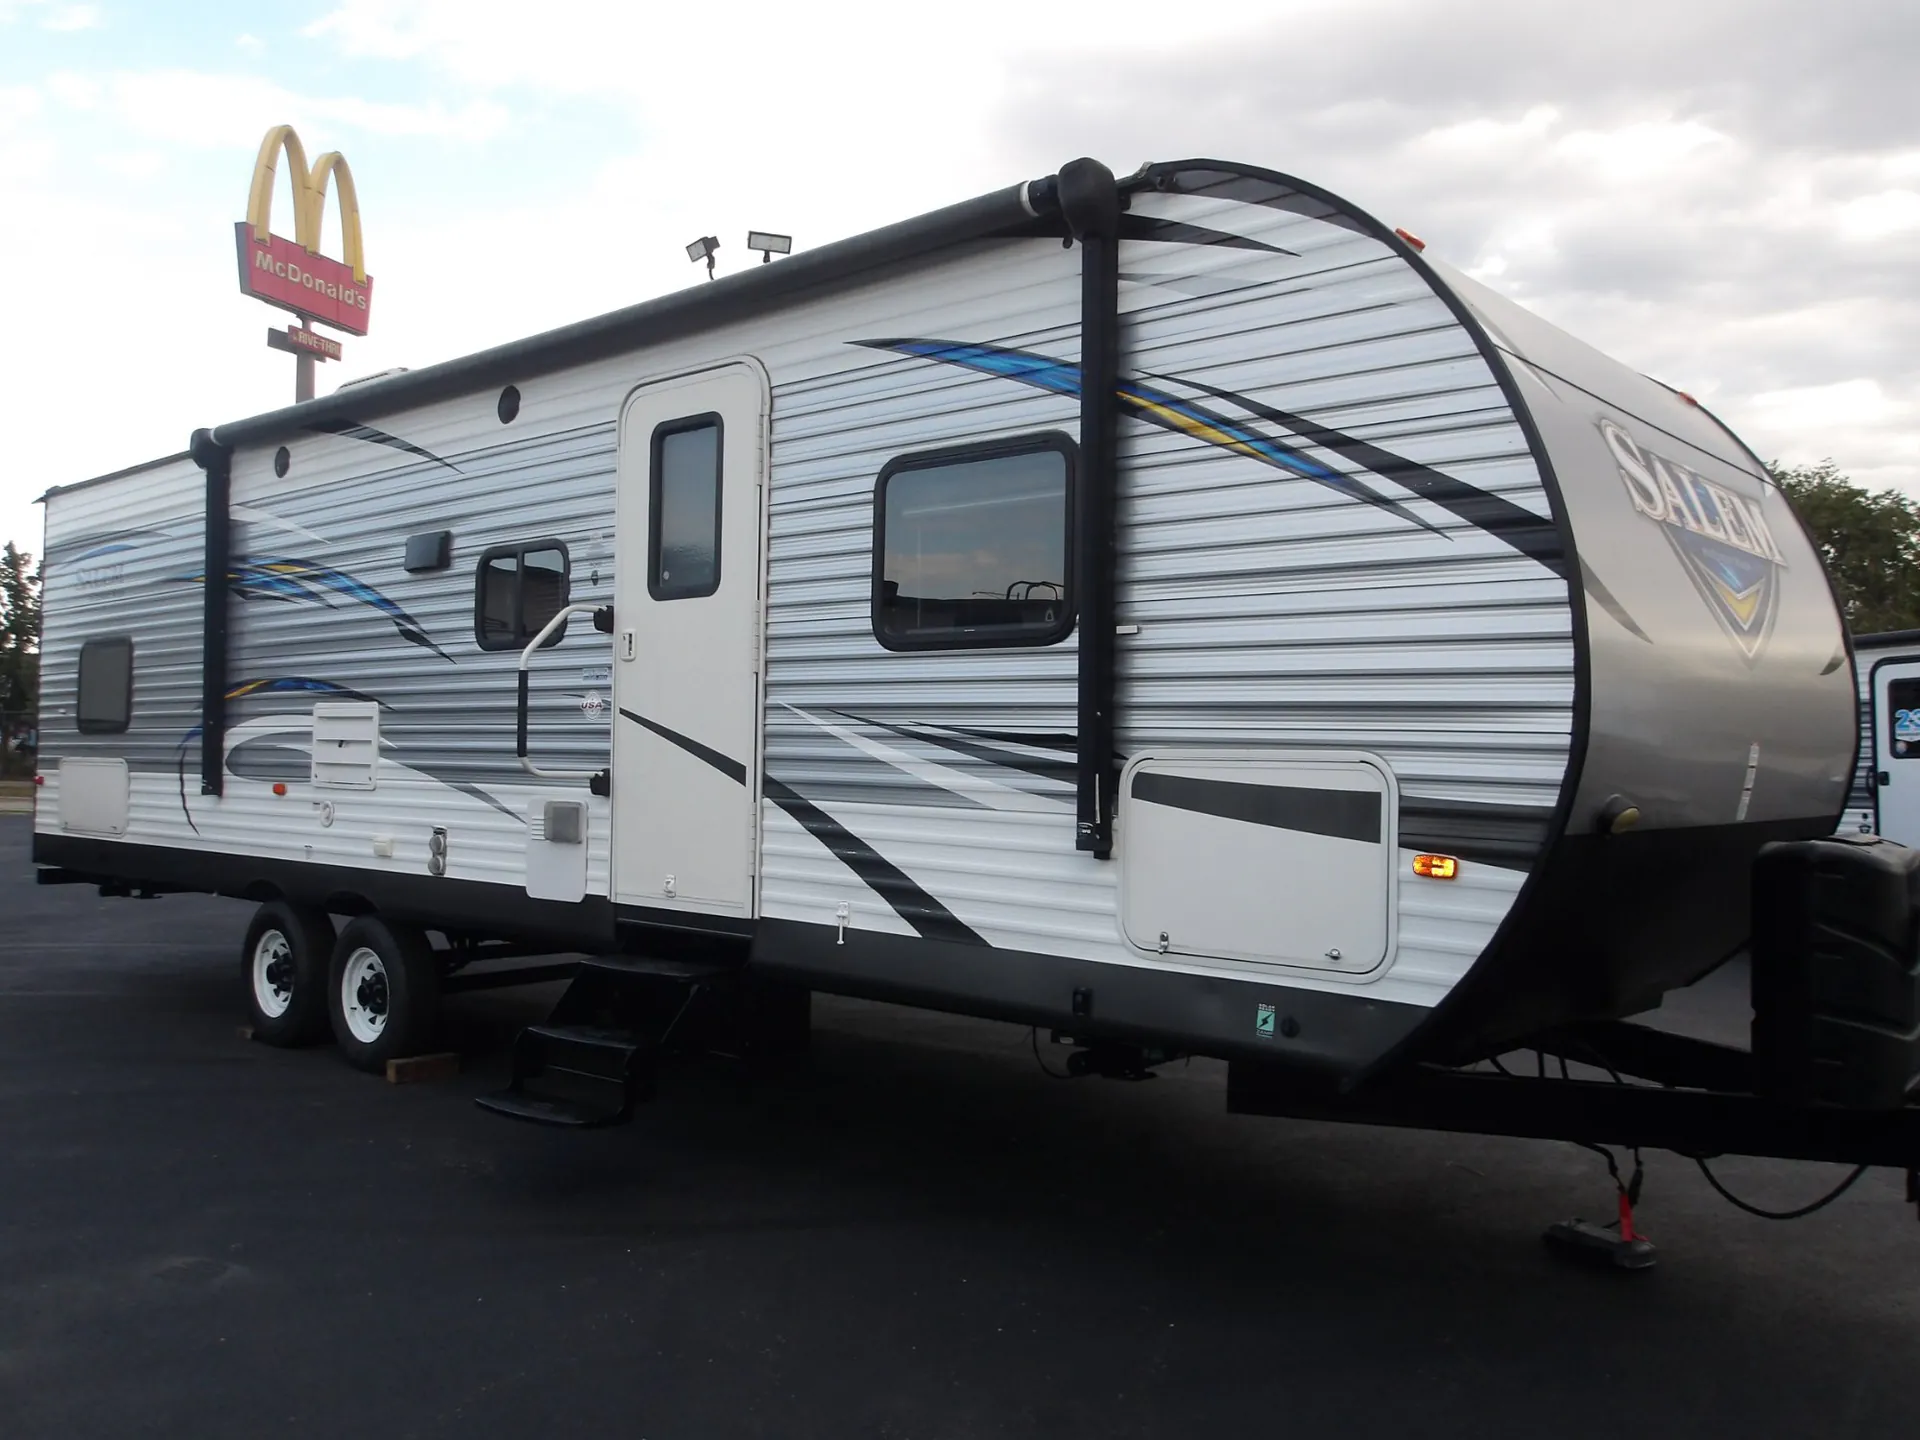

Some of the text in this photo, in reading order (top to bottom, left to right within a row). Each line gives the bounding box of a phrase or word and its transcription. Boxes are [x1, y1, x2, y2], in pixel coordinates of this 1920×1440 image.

[255, 250, 367, 311] McDonald's
[1600, 418, 1789, 568] SALEM
[581, 701, 603, 709] USA
